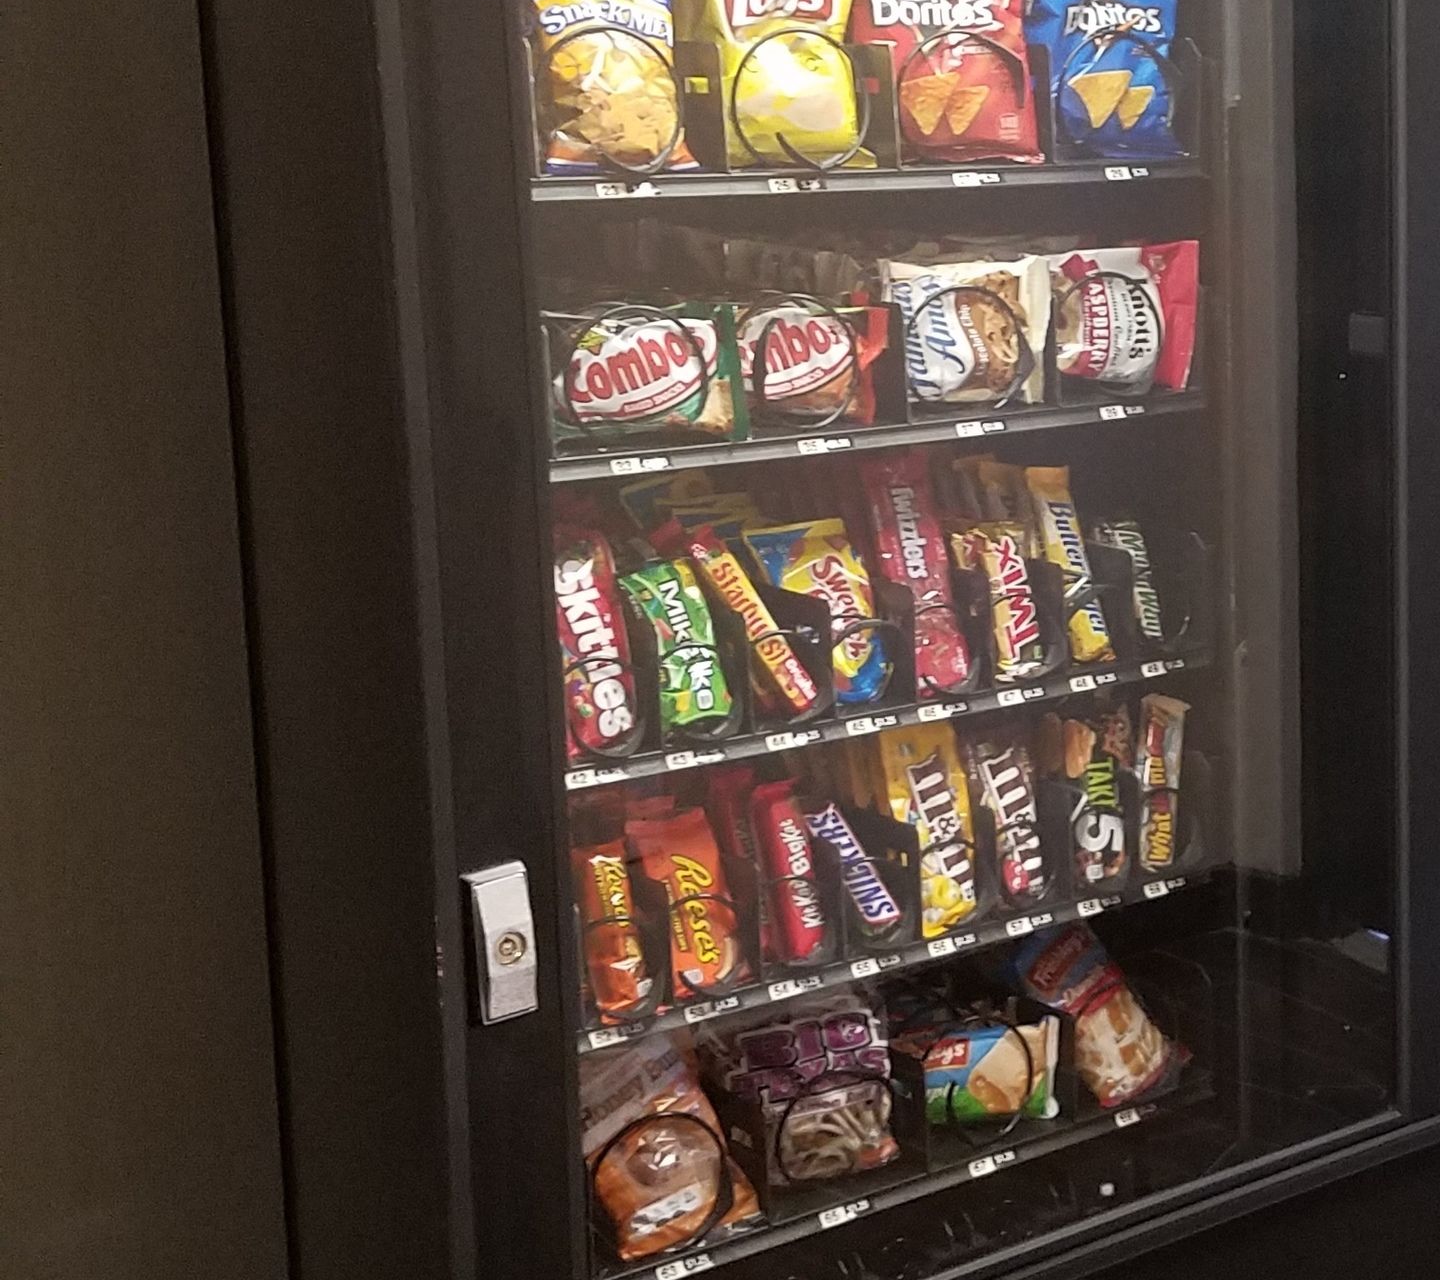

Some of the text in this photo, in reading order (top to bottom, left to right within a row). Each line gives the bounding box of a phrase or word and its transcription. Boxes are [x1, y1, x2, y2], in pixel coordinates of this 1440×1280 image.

[1064, 0, 1162, 37] Doritos
[1126, 278, 1153, 361] Knott's
[890, 484, 929, 580] Twizzlers
[554, 557, 634, 738] Skittles
[669, 853, 721, 964] Reese's
